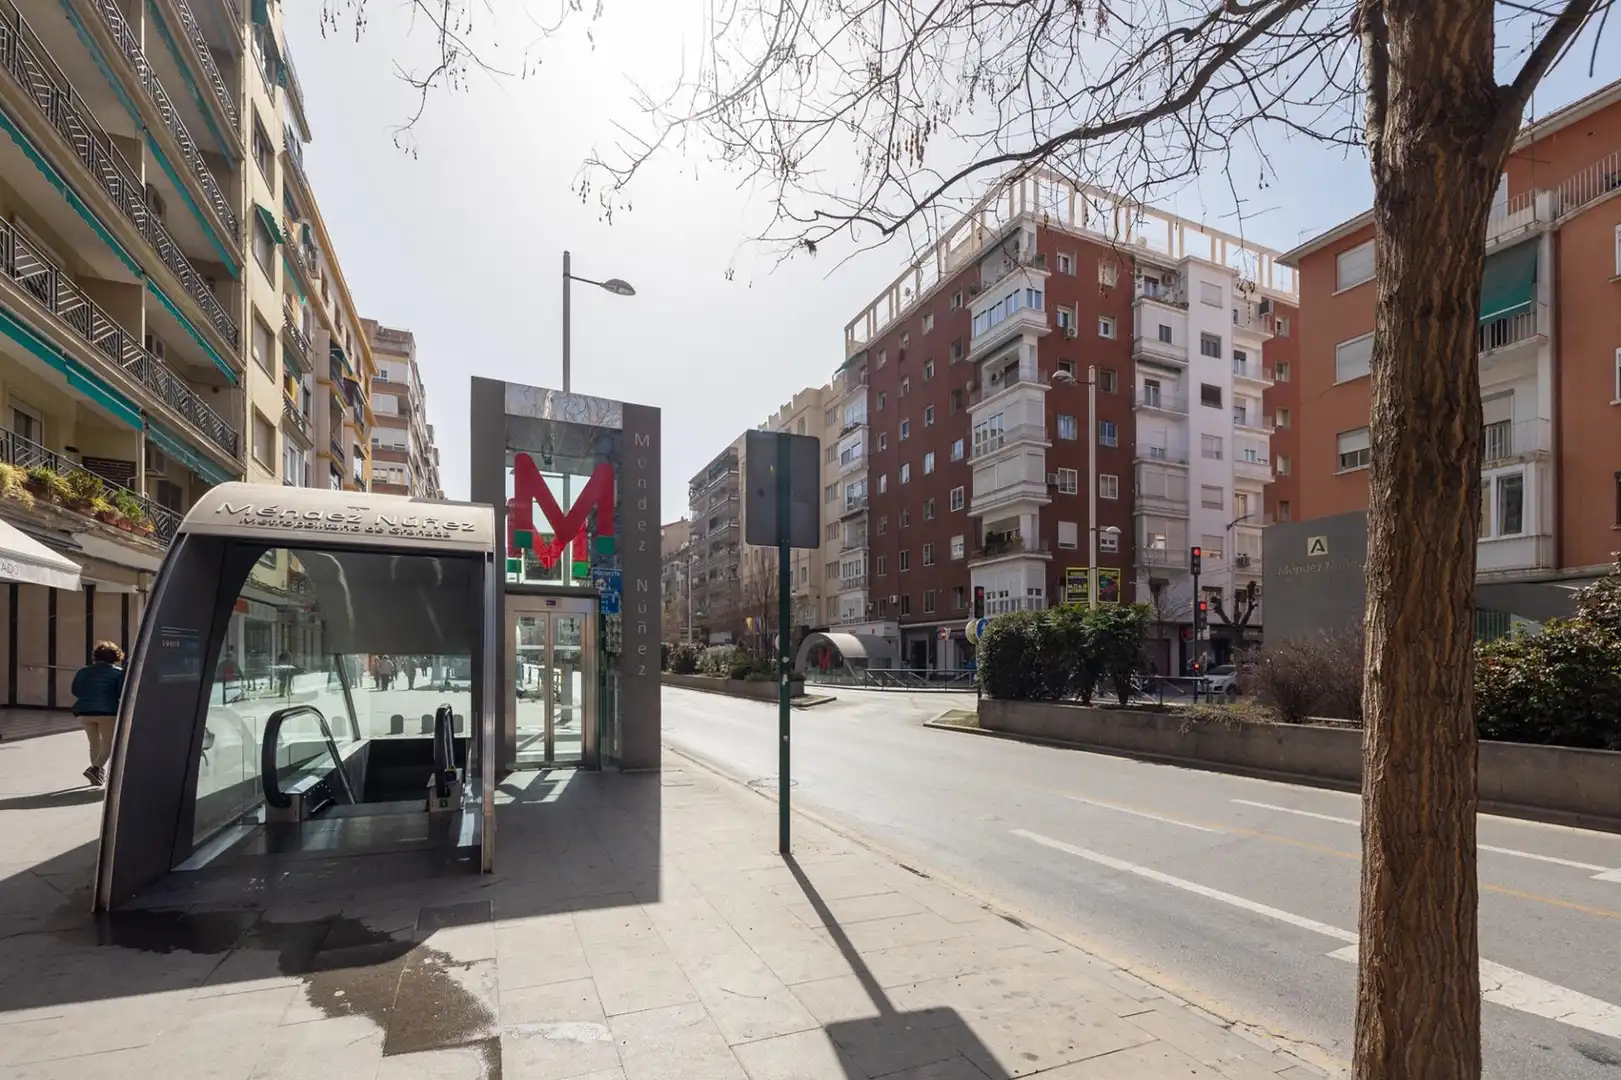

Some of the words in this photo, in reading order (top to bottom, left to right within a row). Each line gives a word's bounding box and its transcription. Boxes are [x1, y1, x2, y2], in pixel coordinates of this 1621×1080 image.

[214, 502, 363, 525] Méndez
[374, 513, 476, 533] Núñez
[513, 452, 616, 556] M
[239, 515, 361, 533] Metropolitano
[364, 526, 384, 535] de
[388, 527, 452, 539] Granada
